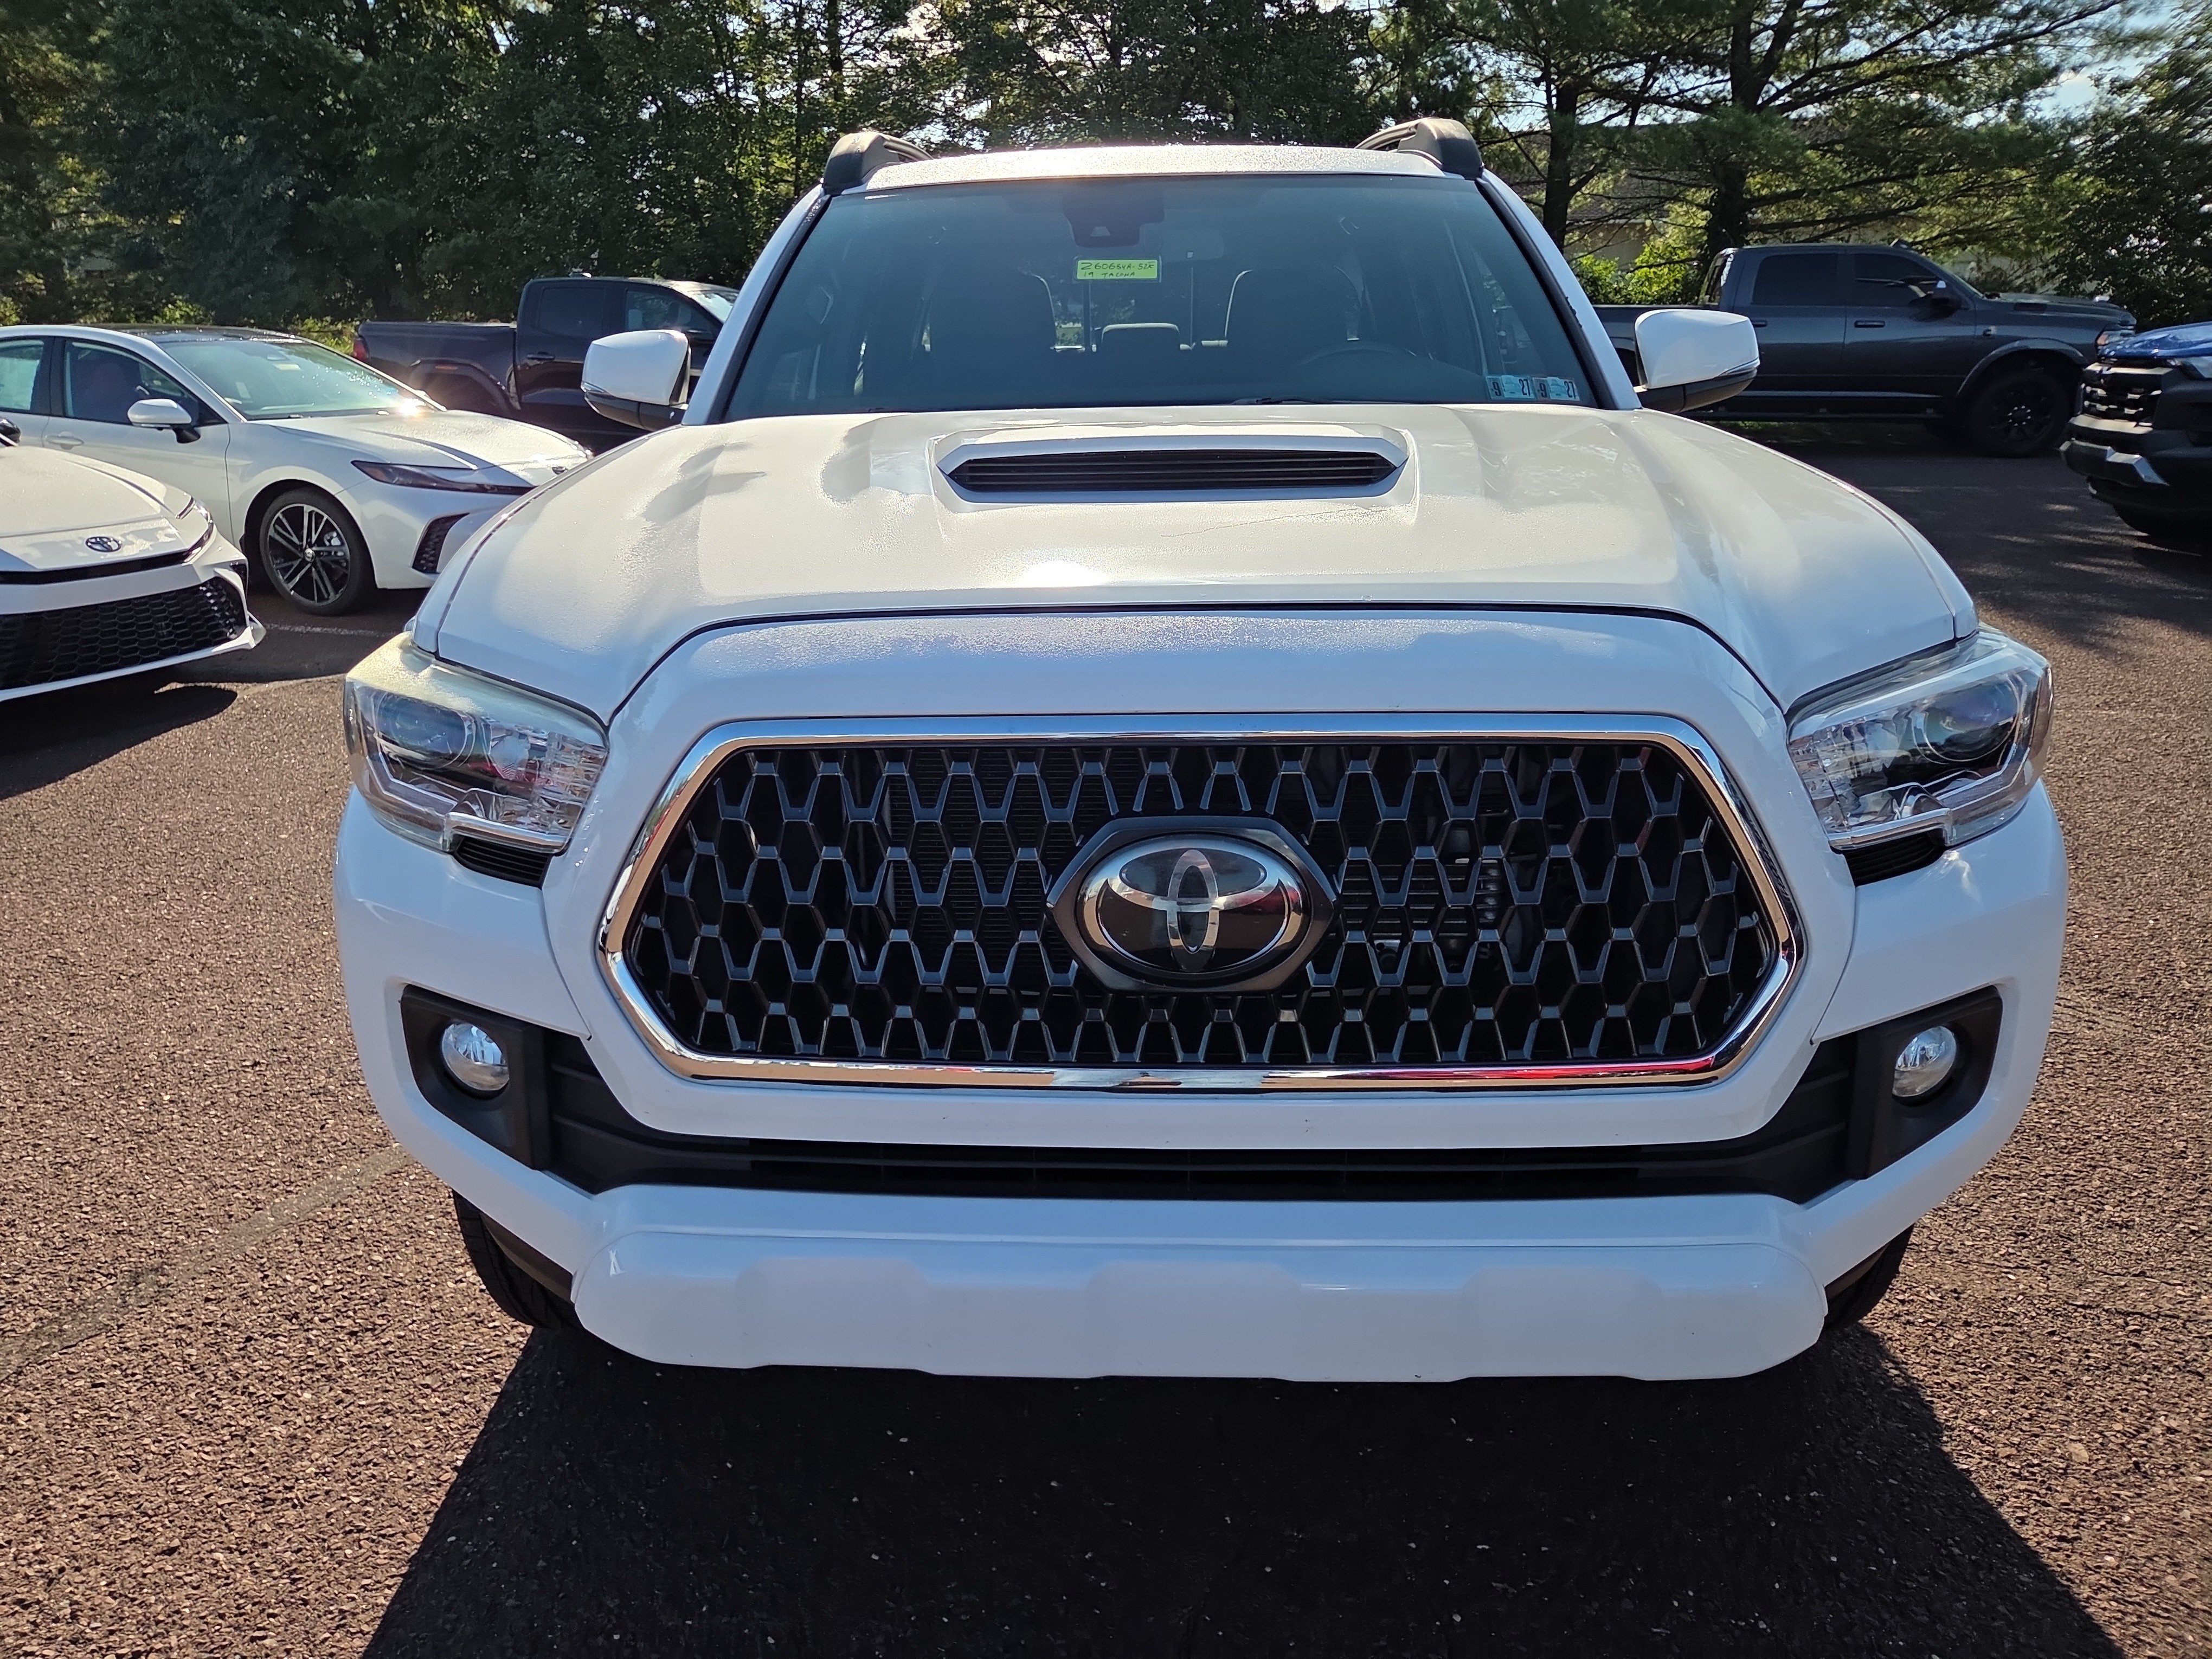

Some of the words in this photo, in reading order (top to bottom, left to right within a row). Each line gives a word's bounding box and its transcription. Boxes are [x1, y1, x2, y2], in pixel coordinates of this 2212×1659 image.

[1492, 381, 1502, 397] 9
[1519, 378, 1531, 396] 27
[1539, 383, 1547, 398] 9
[1564, 381, 1576, 399] 27
